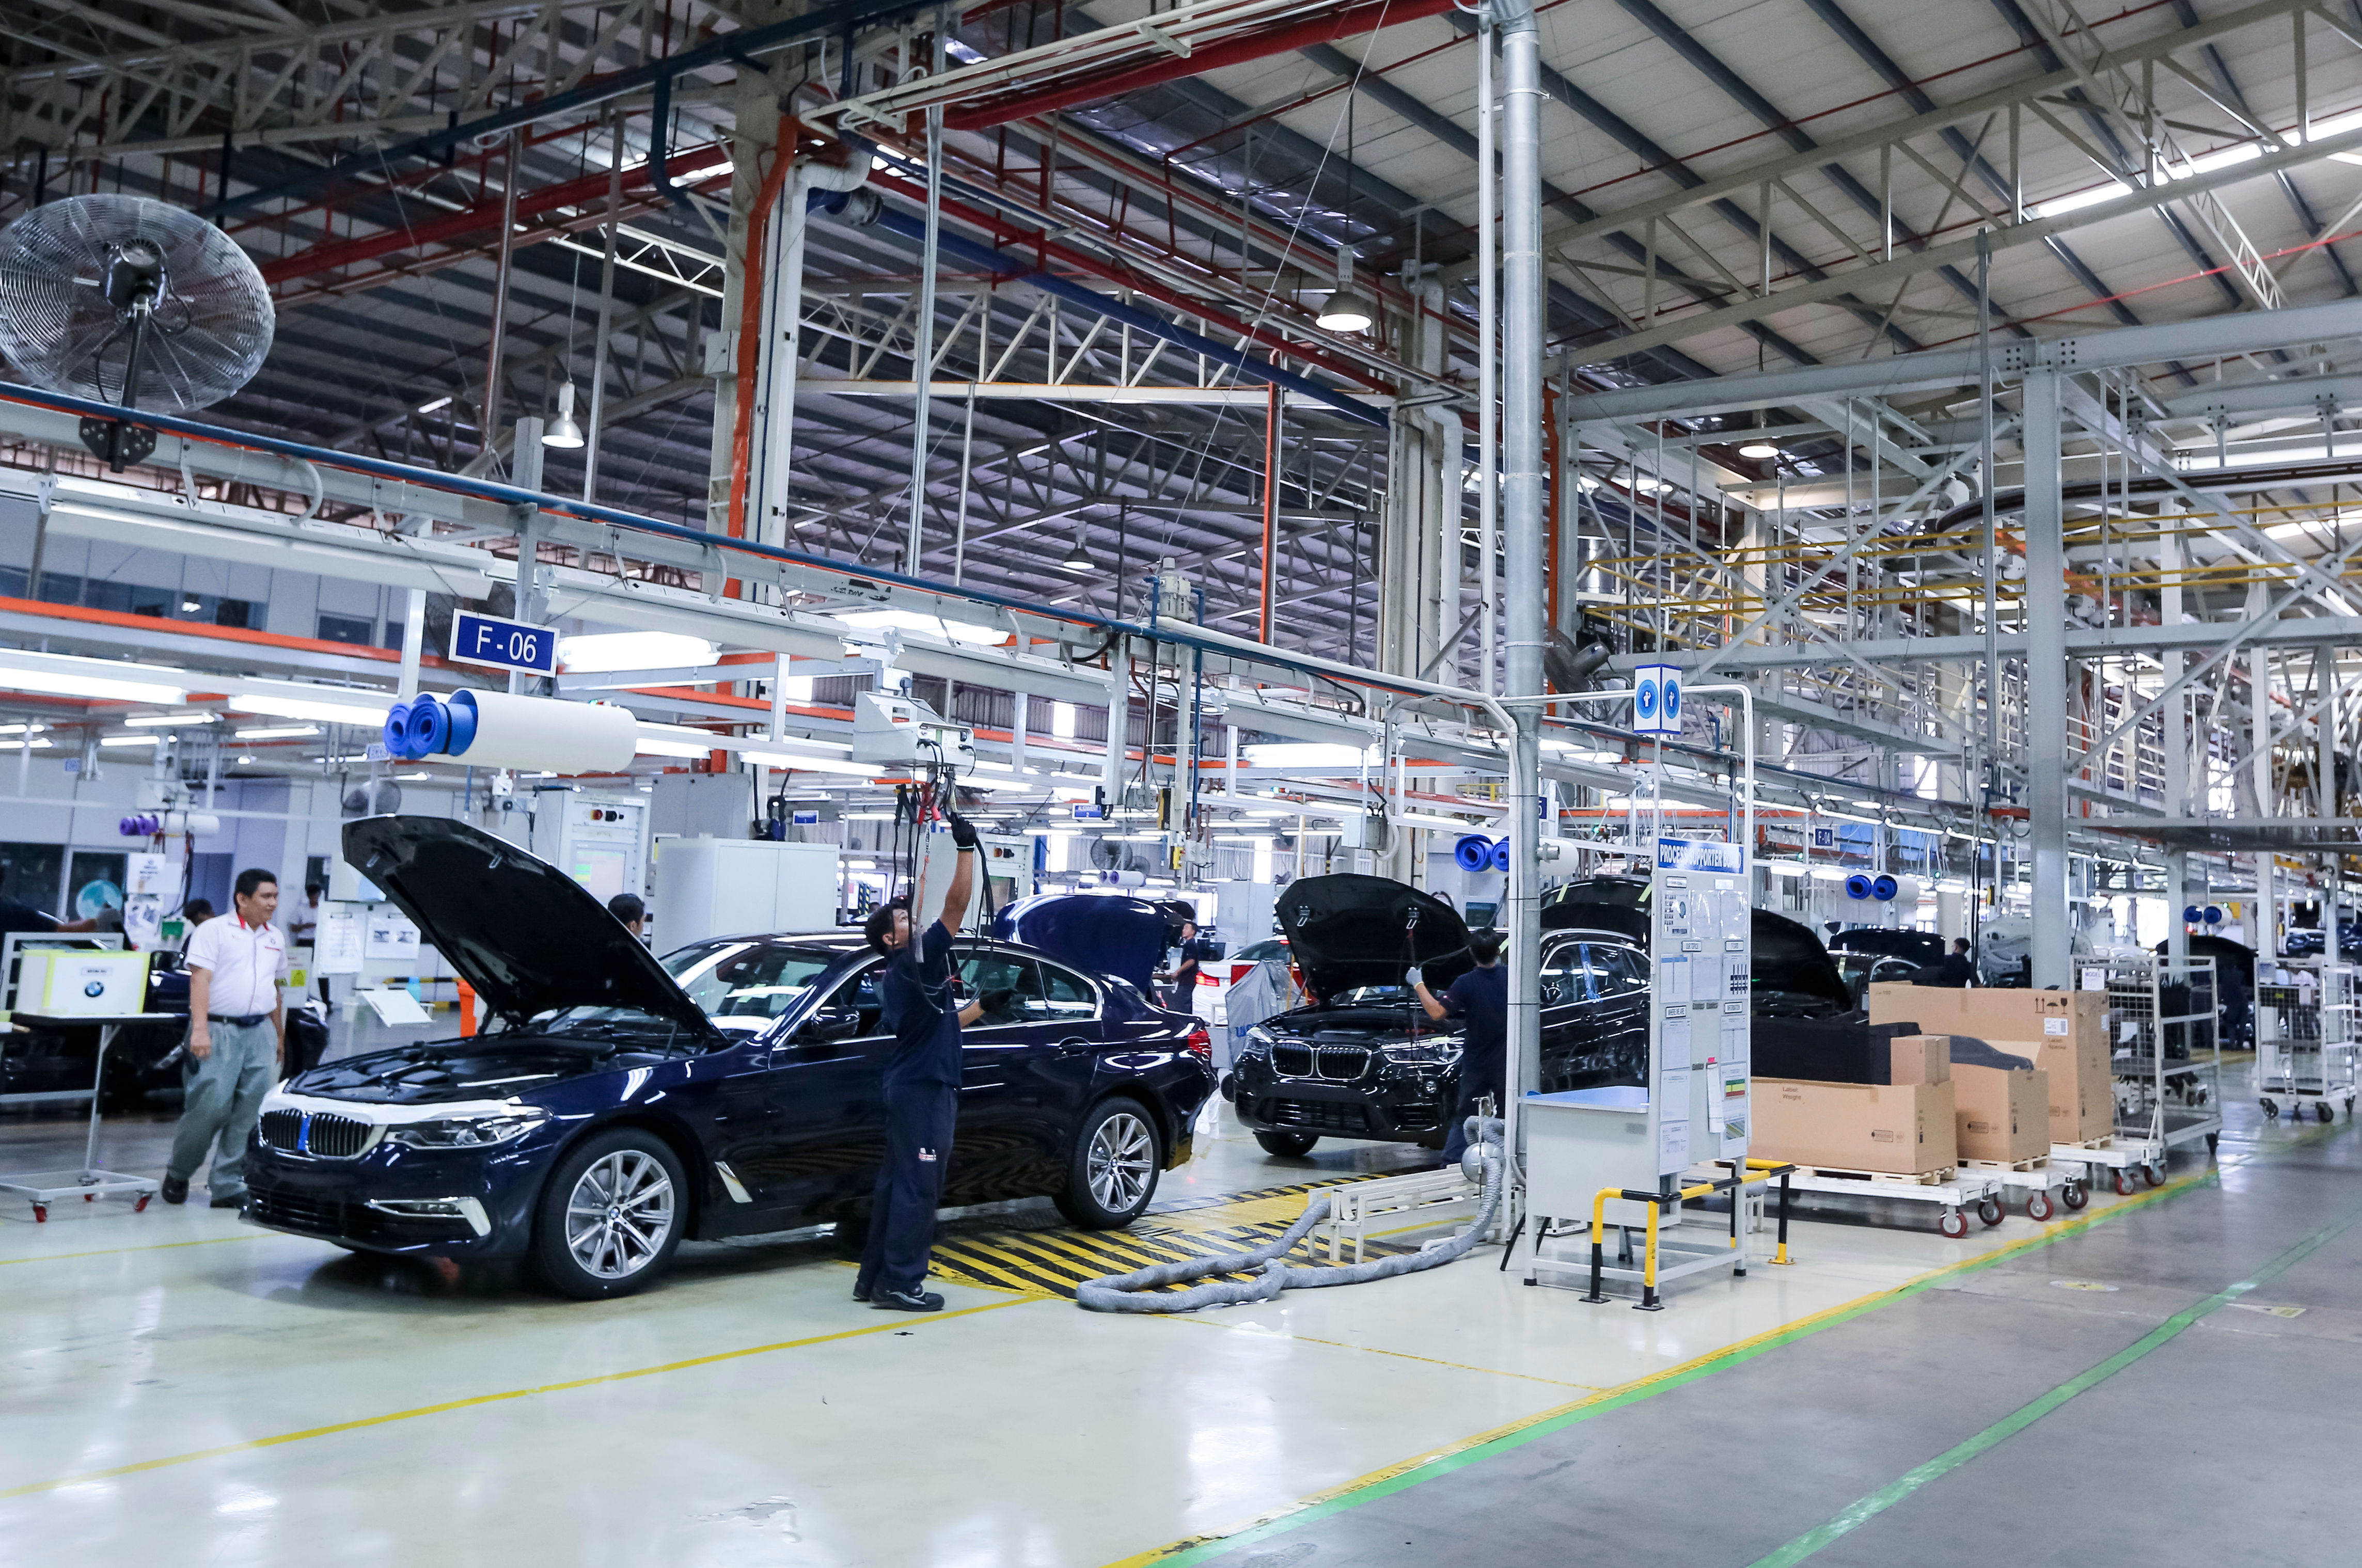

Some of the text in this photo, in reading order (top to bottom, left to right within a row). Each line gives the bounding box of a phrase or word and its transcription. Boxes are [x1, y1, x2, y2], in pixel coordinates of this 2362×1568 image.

[1660, 844, 1741, 869] PROCESS SUPPORTER BOD
